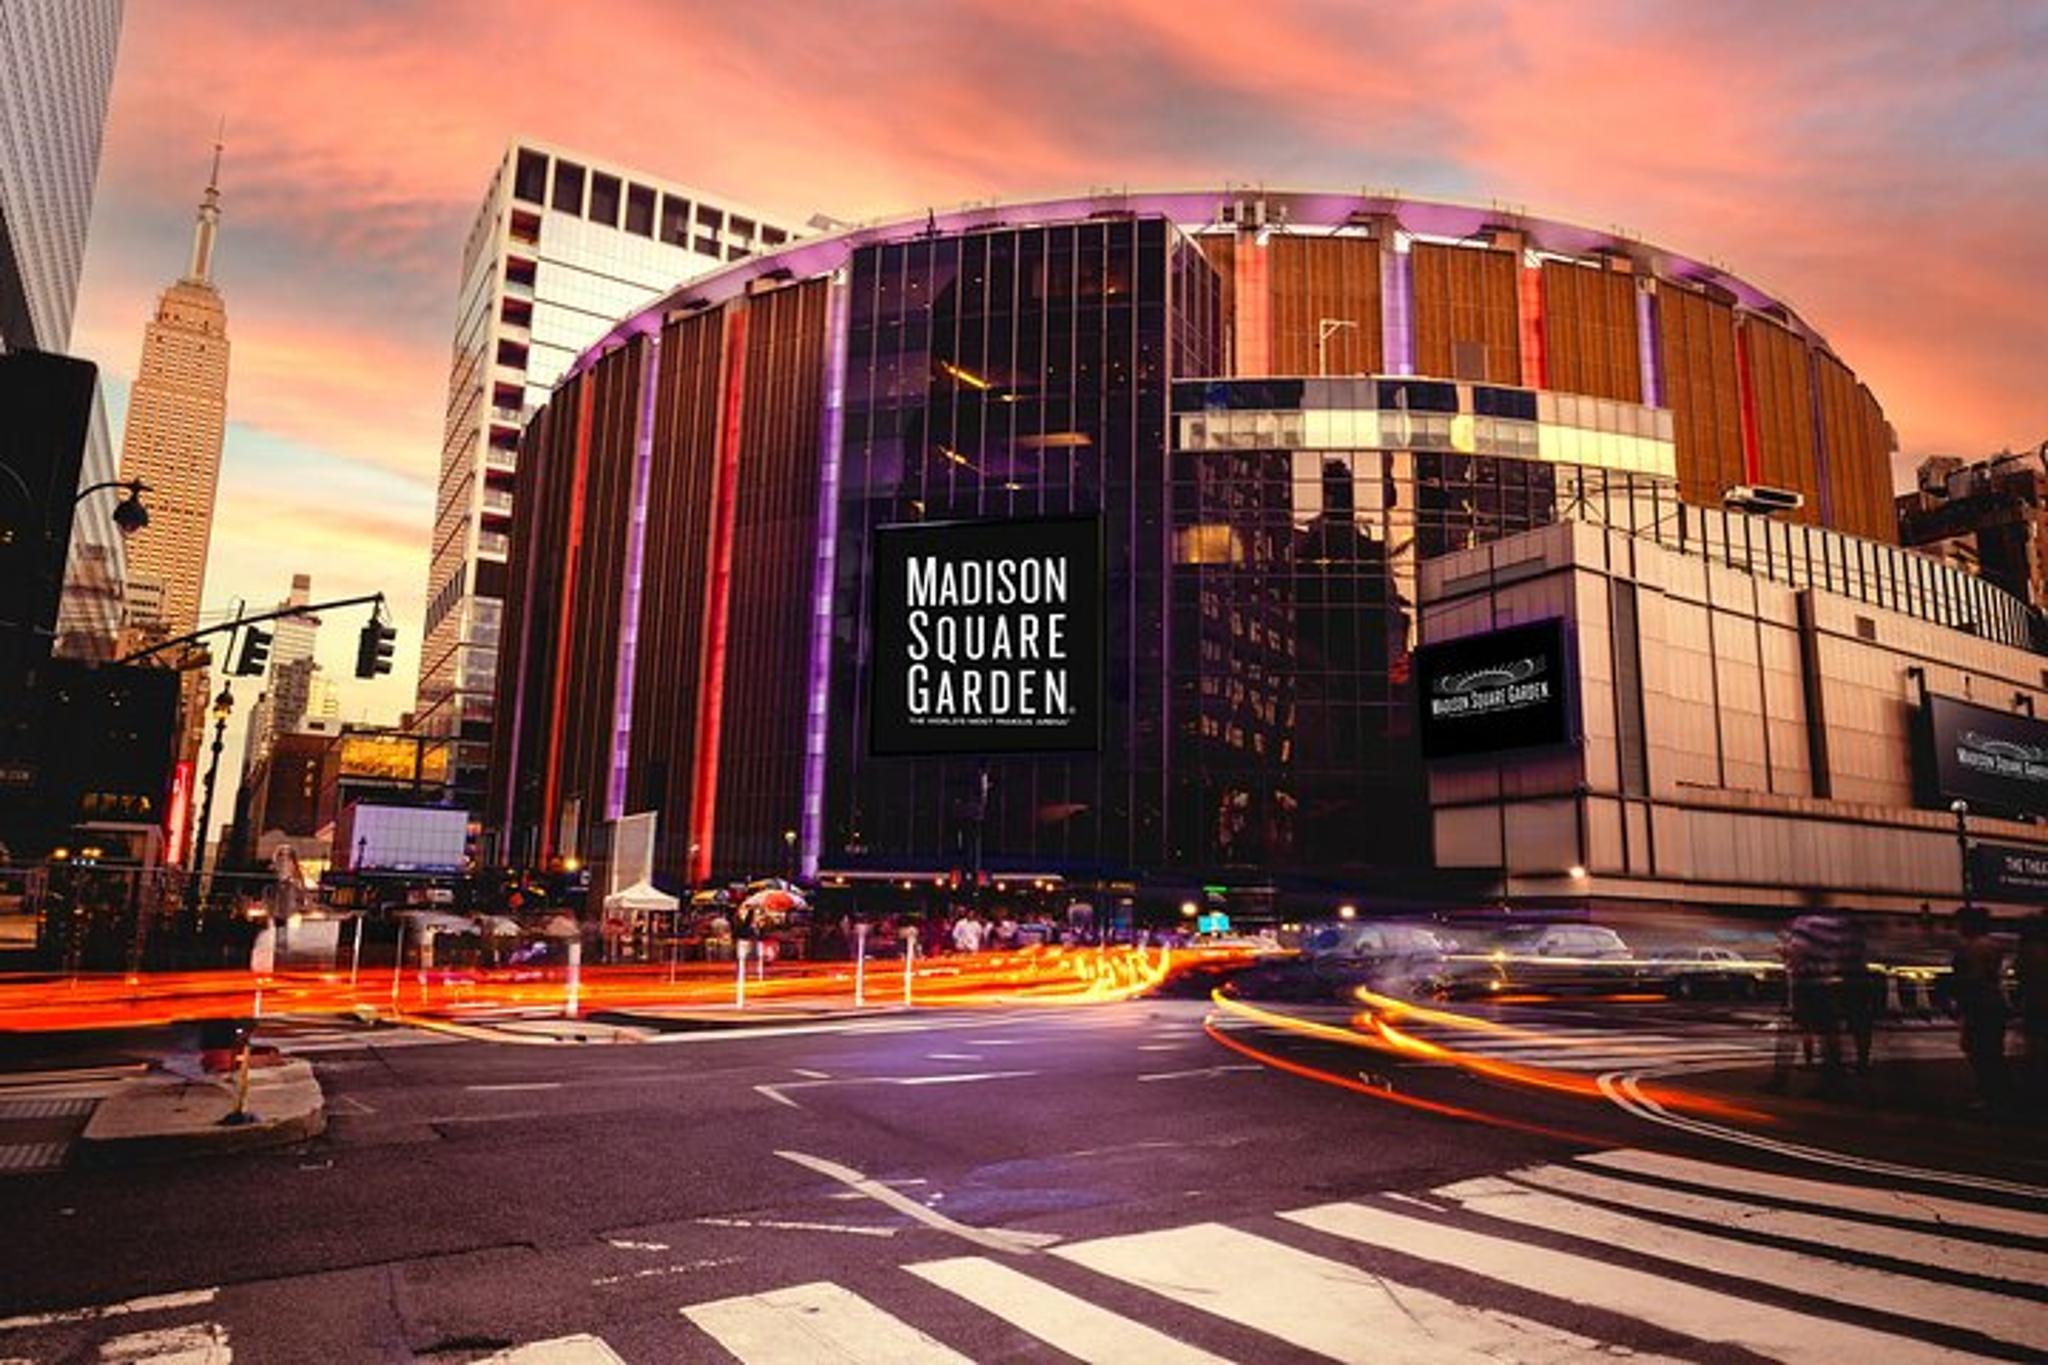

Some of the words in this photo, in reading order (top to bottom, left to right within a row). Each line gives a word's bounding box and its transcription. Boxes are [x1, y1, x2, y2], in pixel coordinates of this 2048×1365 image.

[907, 557, 1067, 606] MADISON
[907, 610, 1067, 665] SQUARE
[907, 664, 1067, 714] GARDEN
[1470, 687, 1506, 709] SQUARE
